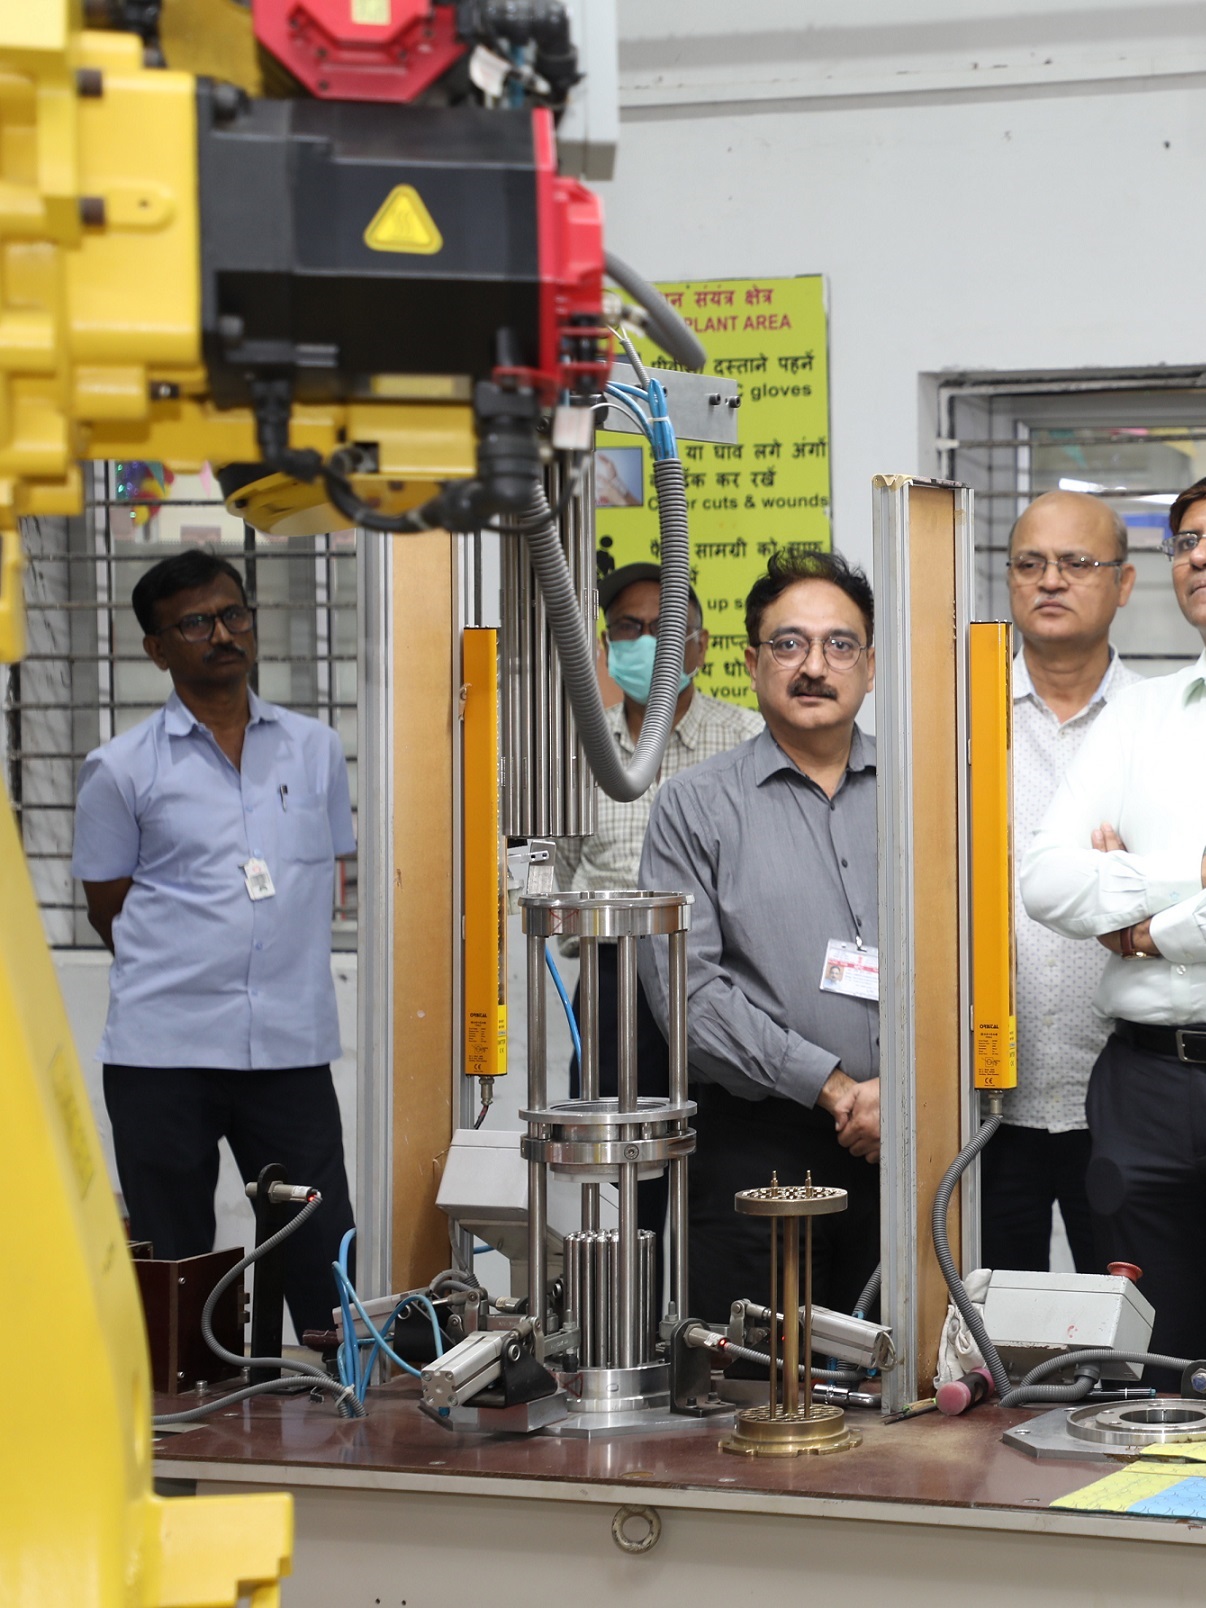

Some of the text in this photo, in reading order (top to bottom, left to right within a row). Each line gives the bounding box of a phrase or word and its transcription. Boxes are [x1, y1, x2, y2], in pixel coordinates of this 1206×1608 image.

[743, 313, 792, 332] AREA
[750, 383, 812, 402] gloves
[716, 471, 741, 489] कर
[702, 496, 738, 511] cuts
[744, 495, 756, 509] &
[762, 493, 829, 509] wounds
[707, 599, 729, 612] up
[710, 685, 749, 698] your
